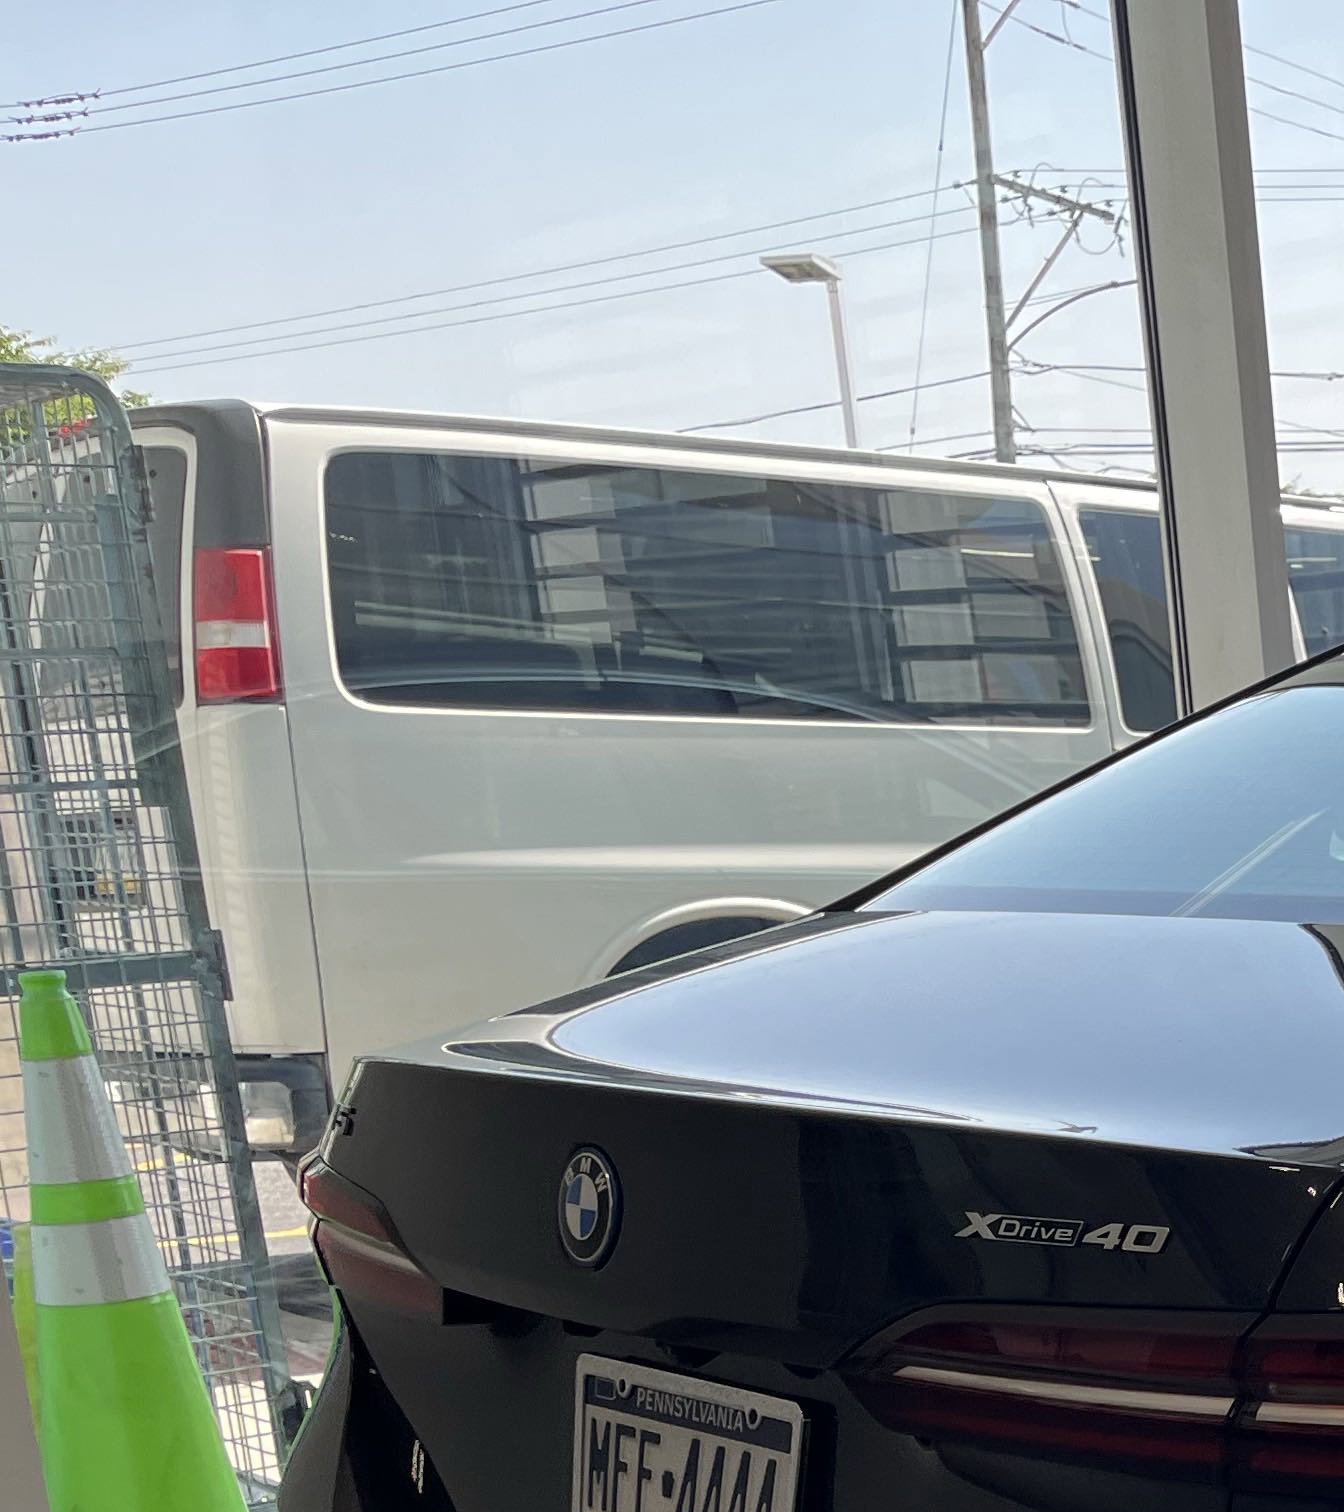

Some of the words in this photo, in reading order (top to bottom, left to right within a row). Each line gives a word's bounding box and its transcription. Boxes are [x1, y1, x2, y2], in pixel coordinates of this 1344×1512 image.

[564, 1157, 609, 1193] BMW
[1082, 1222, 1171, 1254] 40
[635, 1386, 745, 1432] PENNSYLVANIA
